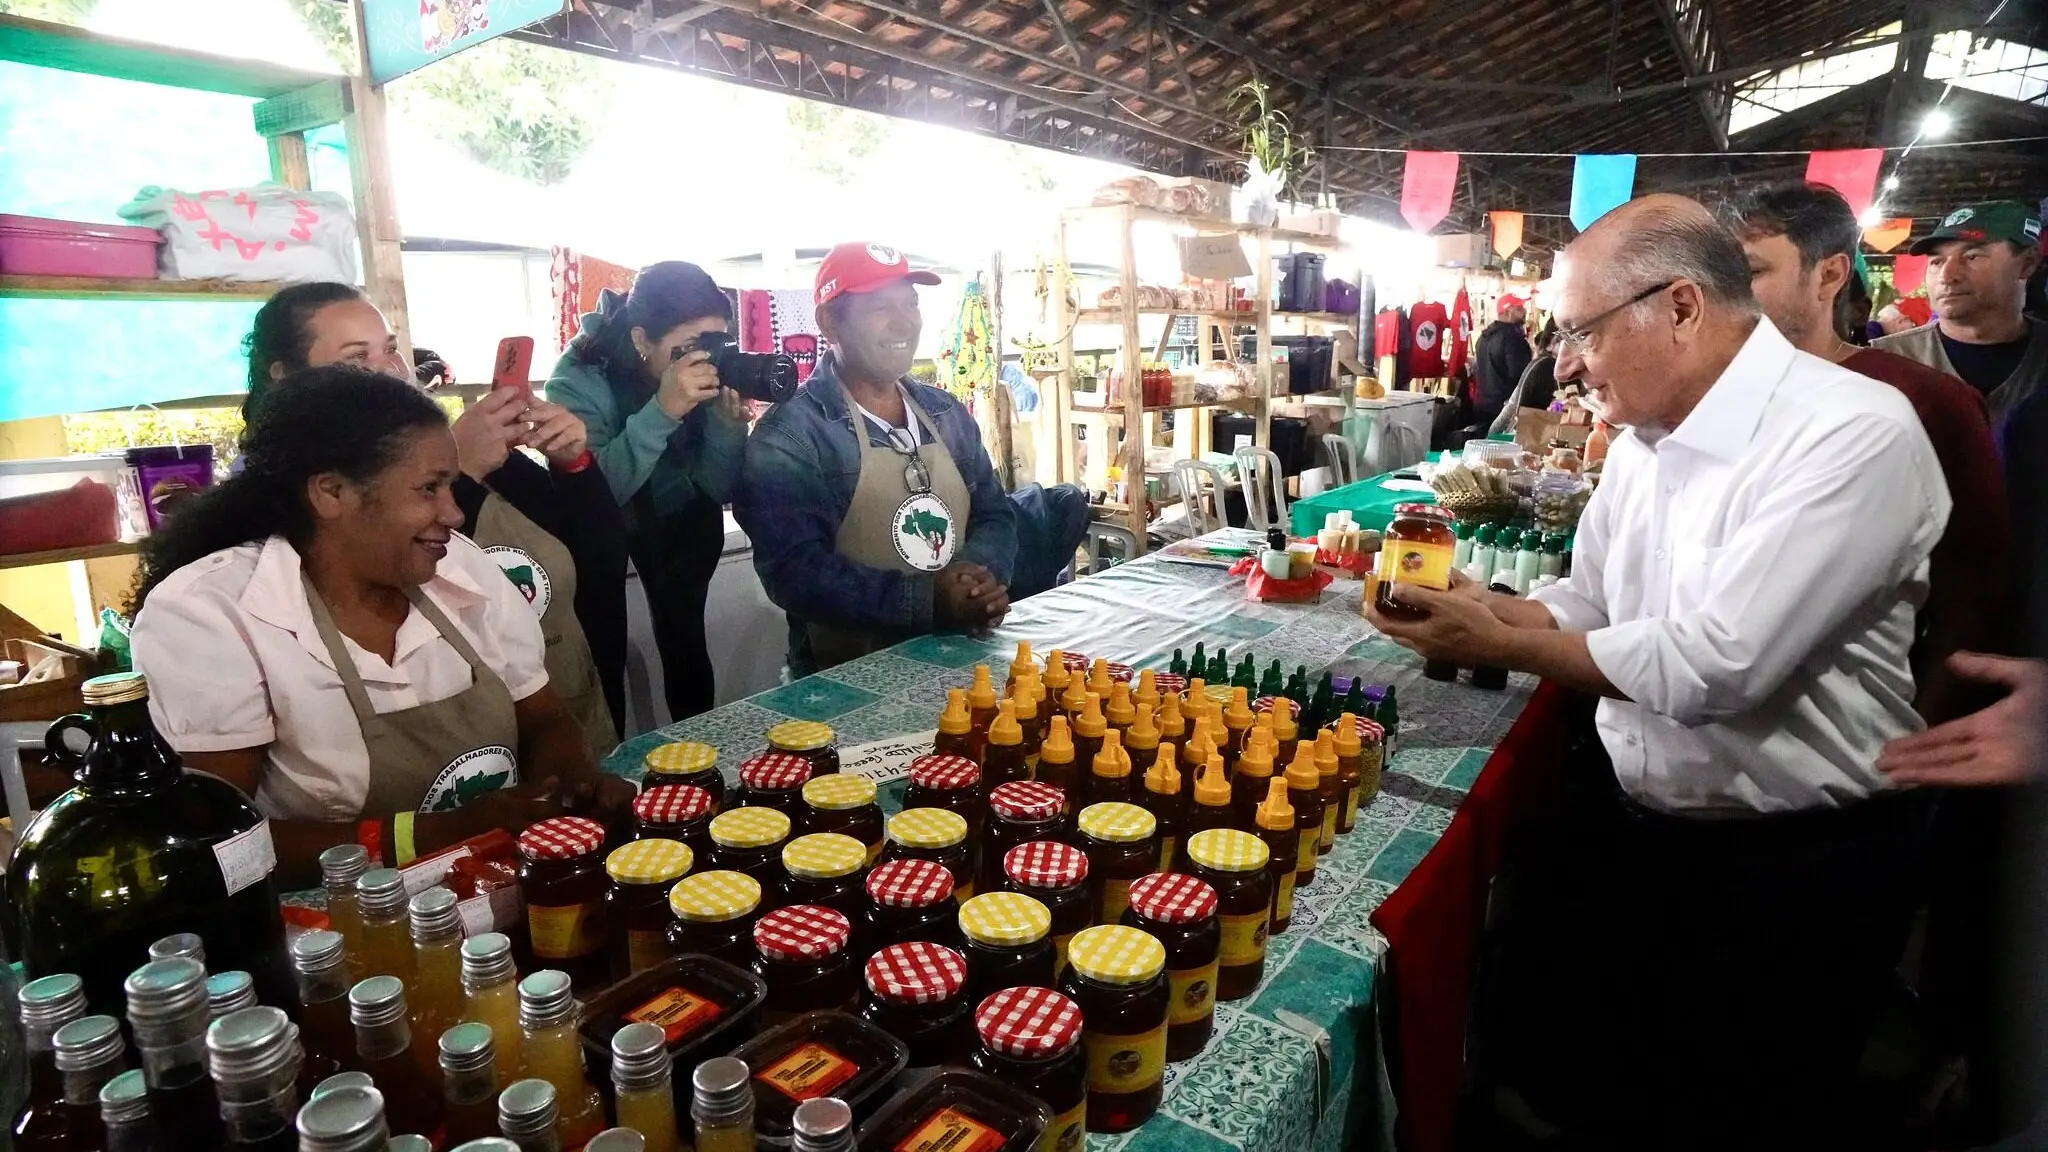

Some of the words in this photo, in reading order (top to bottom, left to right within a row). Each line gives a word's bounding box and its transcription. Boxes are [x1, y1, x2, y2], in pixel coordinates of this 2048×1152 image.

[820, 278, 837, 299] MST
[894, 511, 902, 524] DOS
[893, 525, 910, 560] MOVIMENTO
[512, 549, 536, 567] RURAIS
[535, 565, 548, 581] SEM
[543, 582, 551, 606] TERRA
[424, 787, 439, 805] DOS
[436, 747, 503, 787] TRABALHADORES
